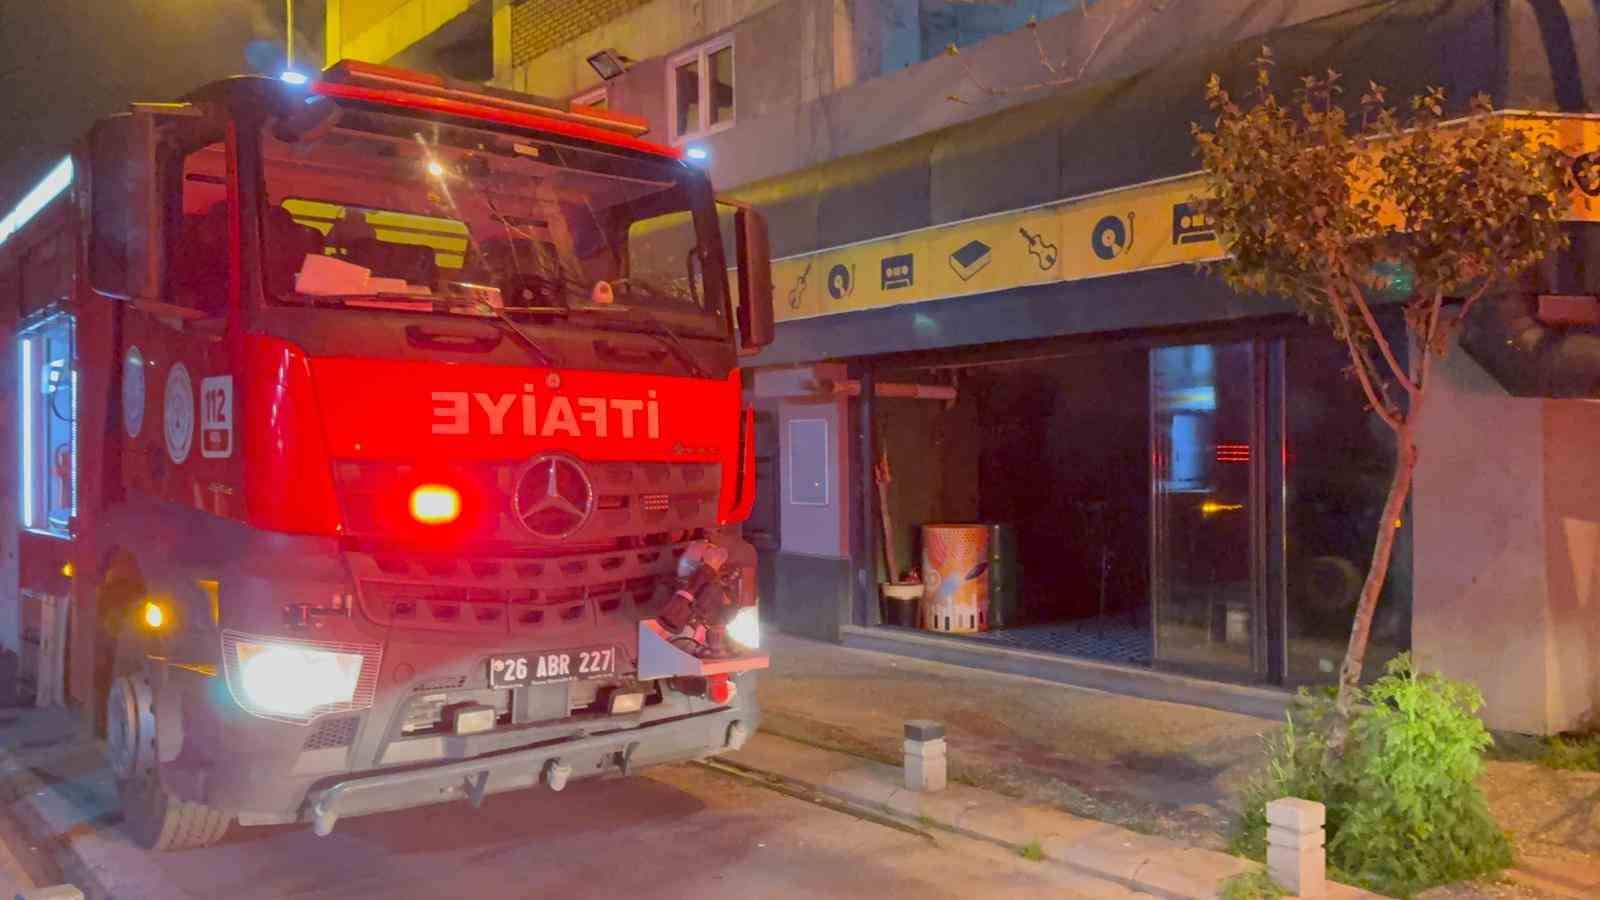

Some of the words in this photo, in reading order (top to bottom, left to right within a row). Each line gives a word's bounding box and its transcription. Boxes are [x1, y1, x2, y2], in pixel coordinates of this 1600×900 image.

[206, 388, 227, 423] 112
[504, 658, 528, 681] 26
[536, 654, 570, 678] ABR
[579, 650, 611, 673] 227
